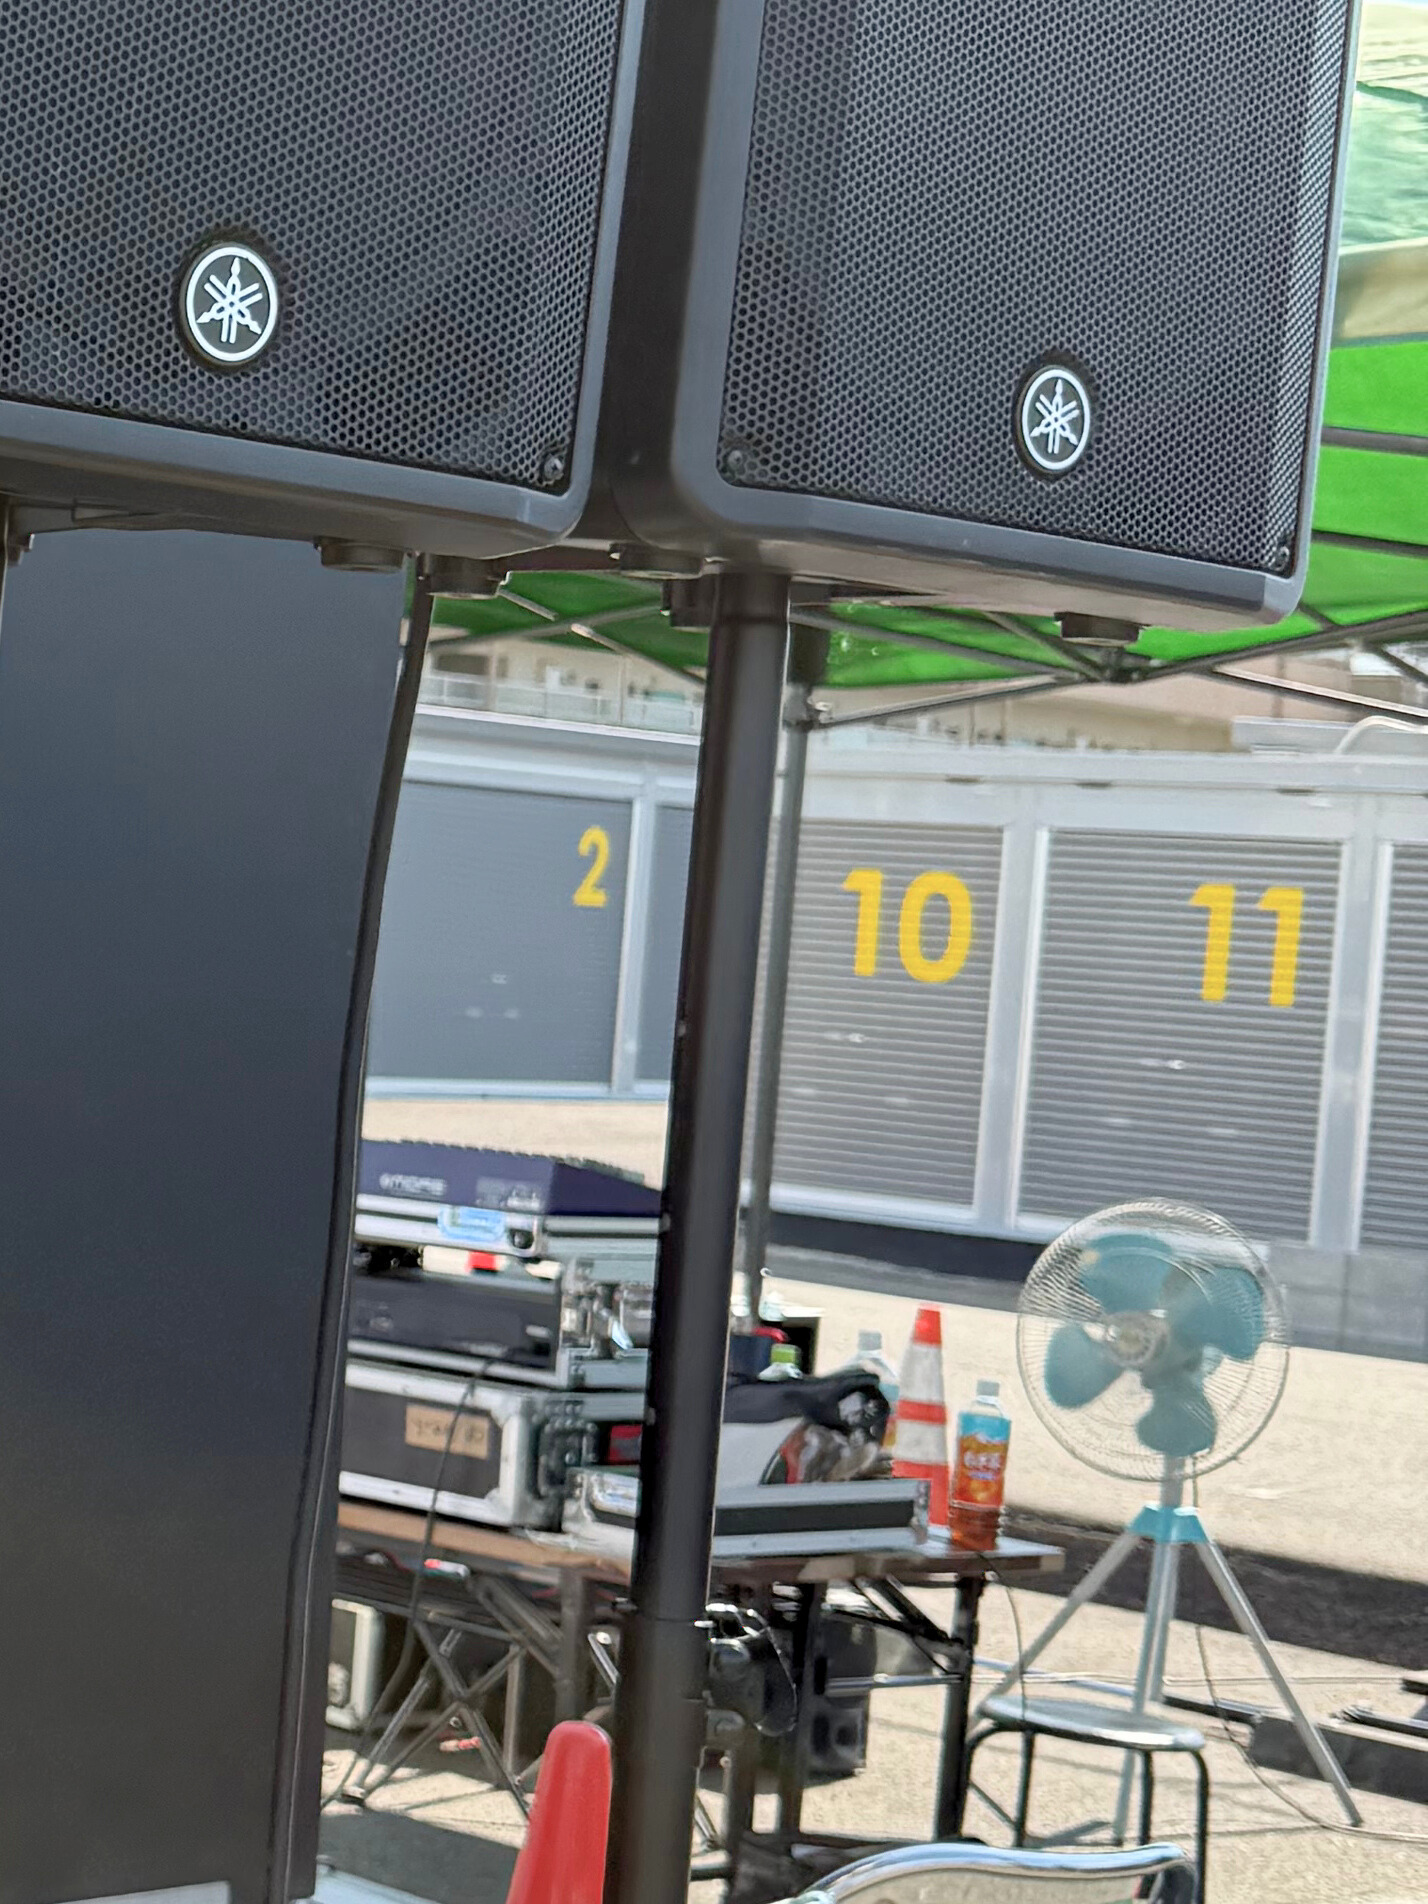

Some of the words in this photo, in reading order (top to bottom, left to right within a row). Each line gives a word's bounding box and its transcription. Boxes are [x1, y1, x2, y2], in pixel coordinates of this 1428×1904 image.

[574, 826, 610, 907] 2
[843, 869, 974, 983] 10
[1190, 884, 1305, 1007] 11
